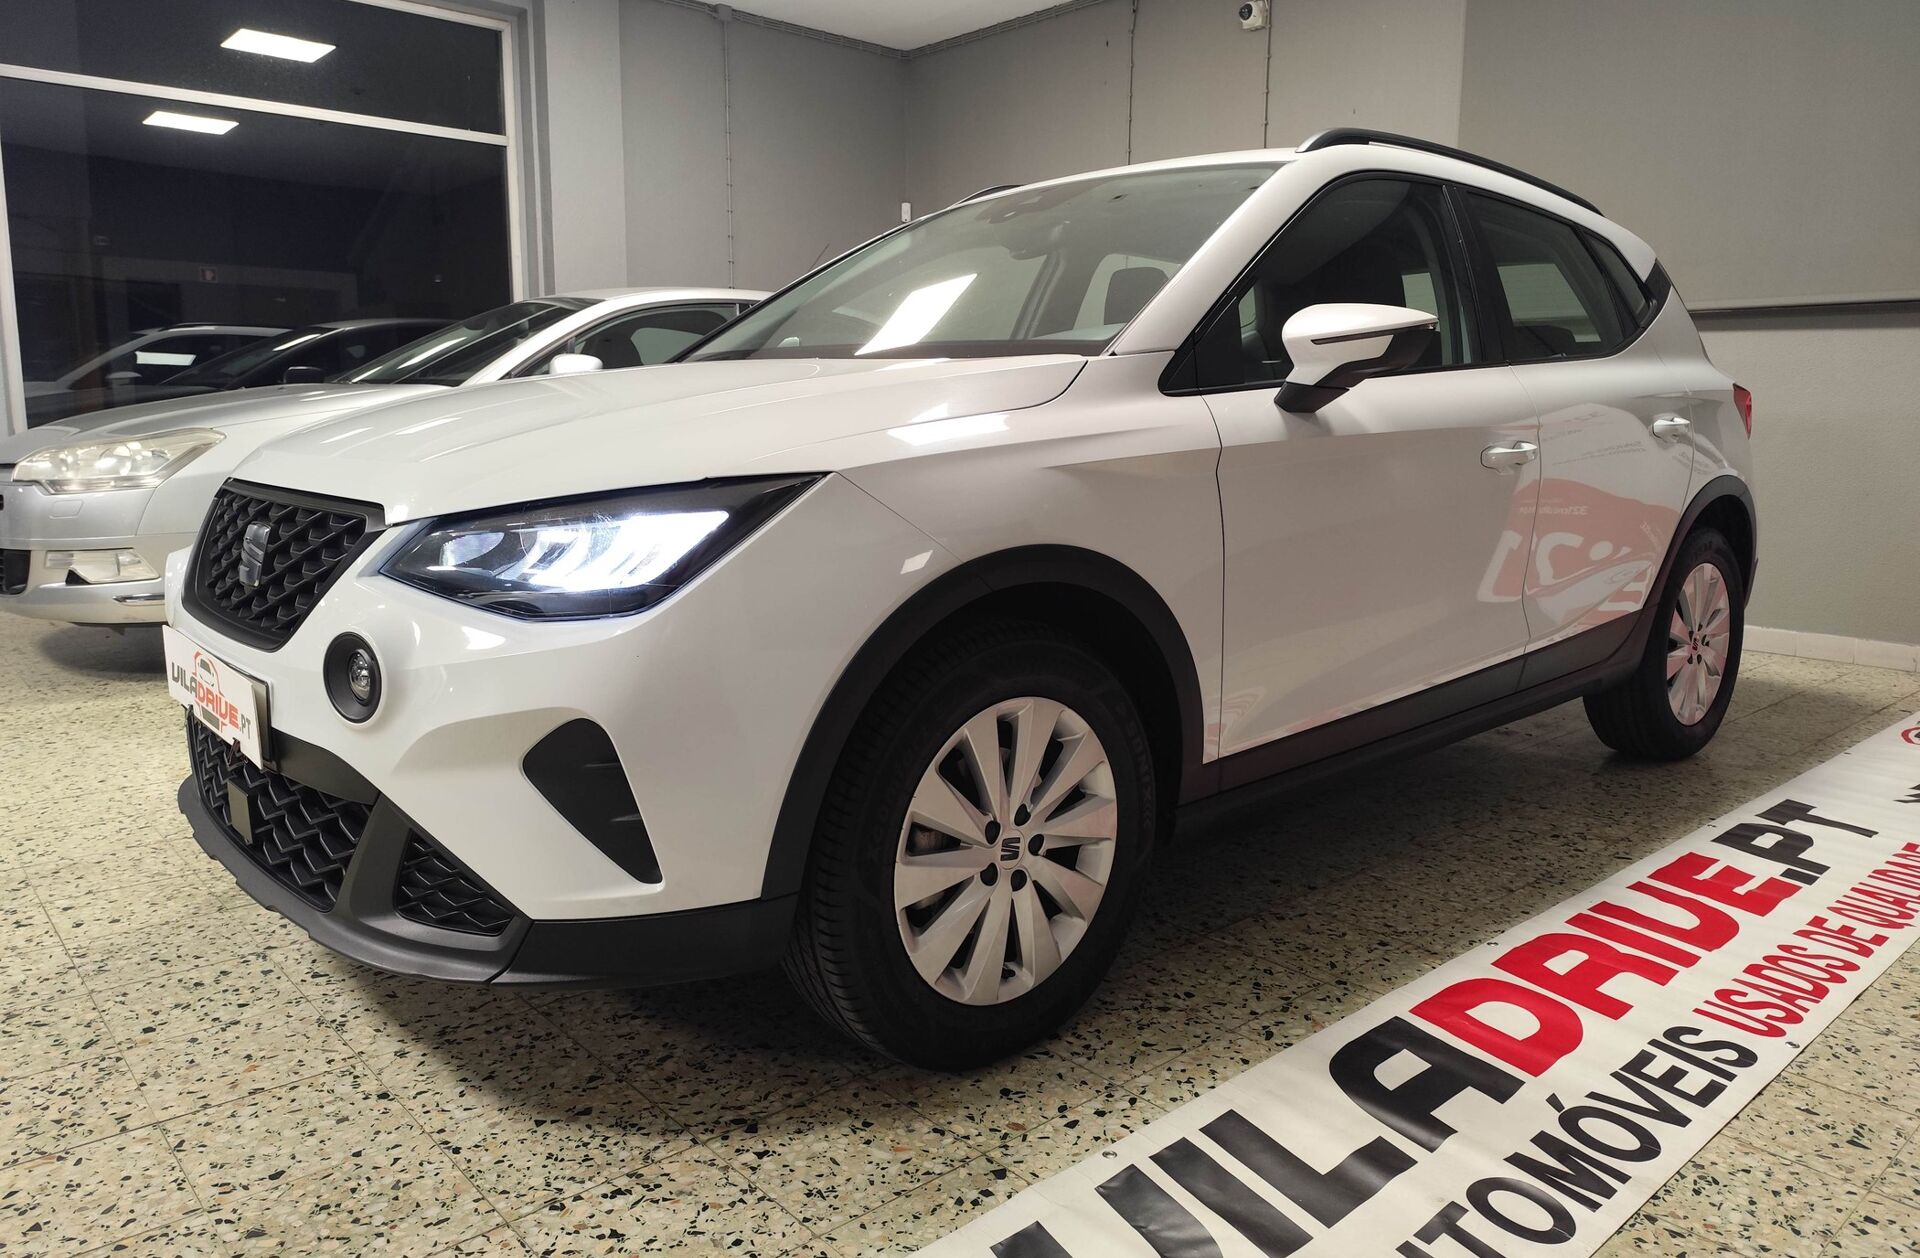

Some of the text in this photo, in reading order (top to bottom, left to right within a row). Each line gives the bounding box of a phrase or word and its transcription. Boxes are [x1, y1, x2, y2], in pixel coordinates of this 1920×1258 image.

[1395, 1026, 1759, 1258] TOMÓVEIS
[1691, 944, 1861, 1038] USADOS
[1792, 915, 1890, 959] DE
